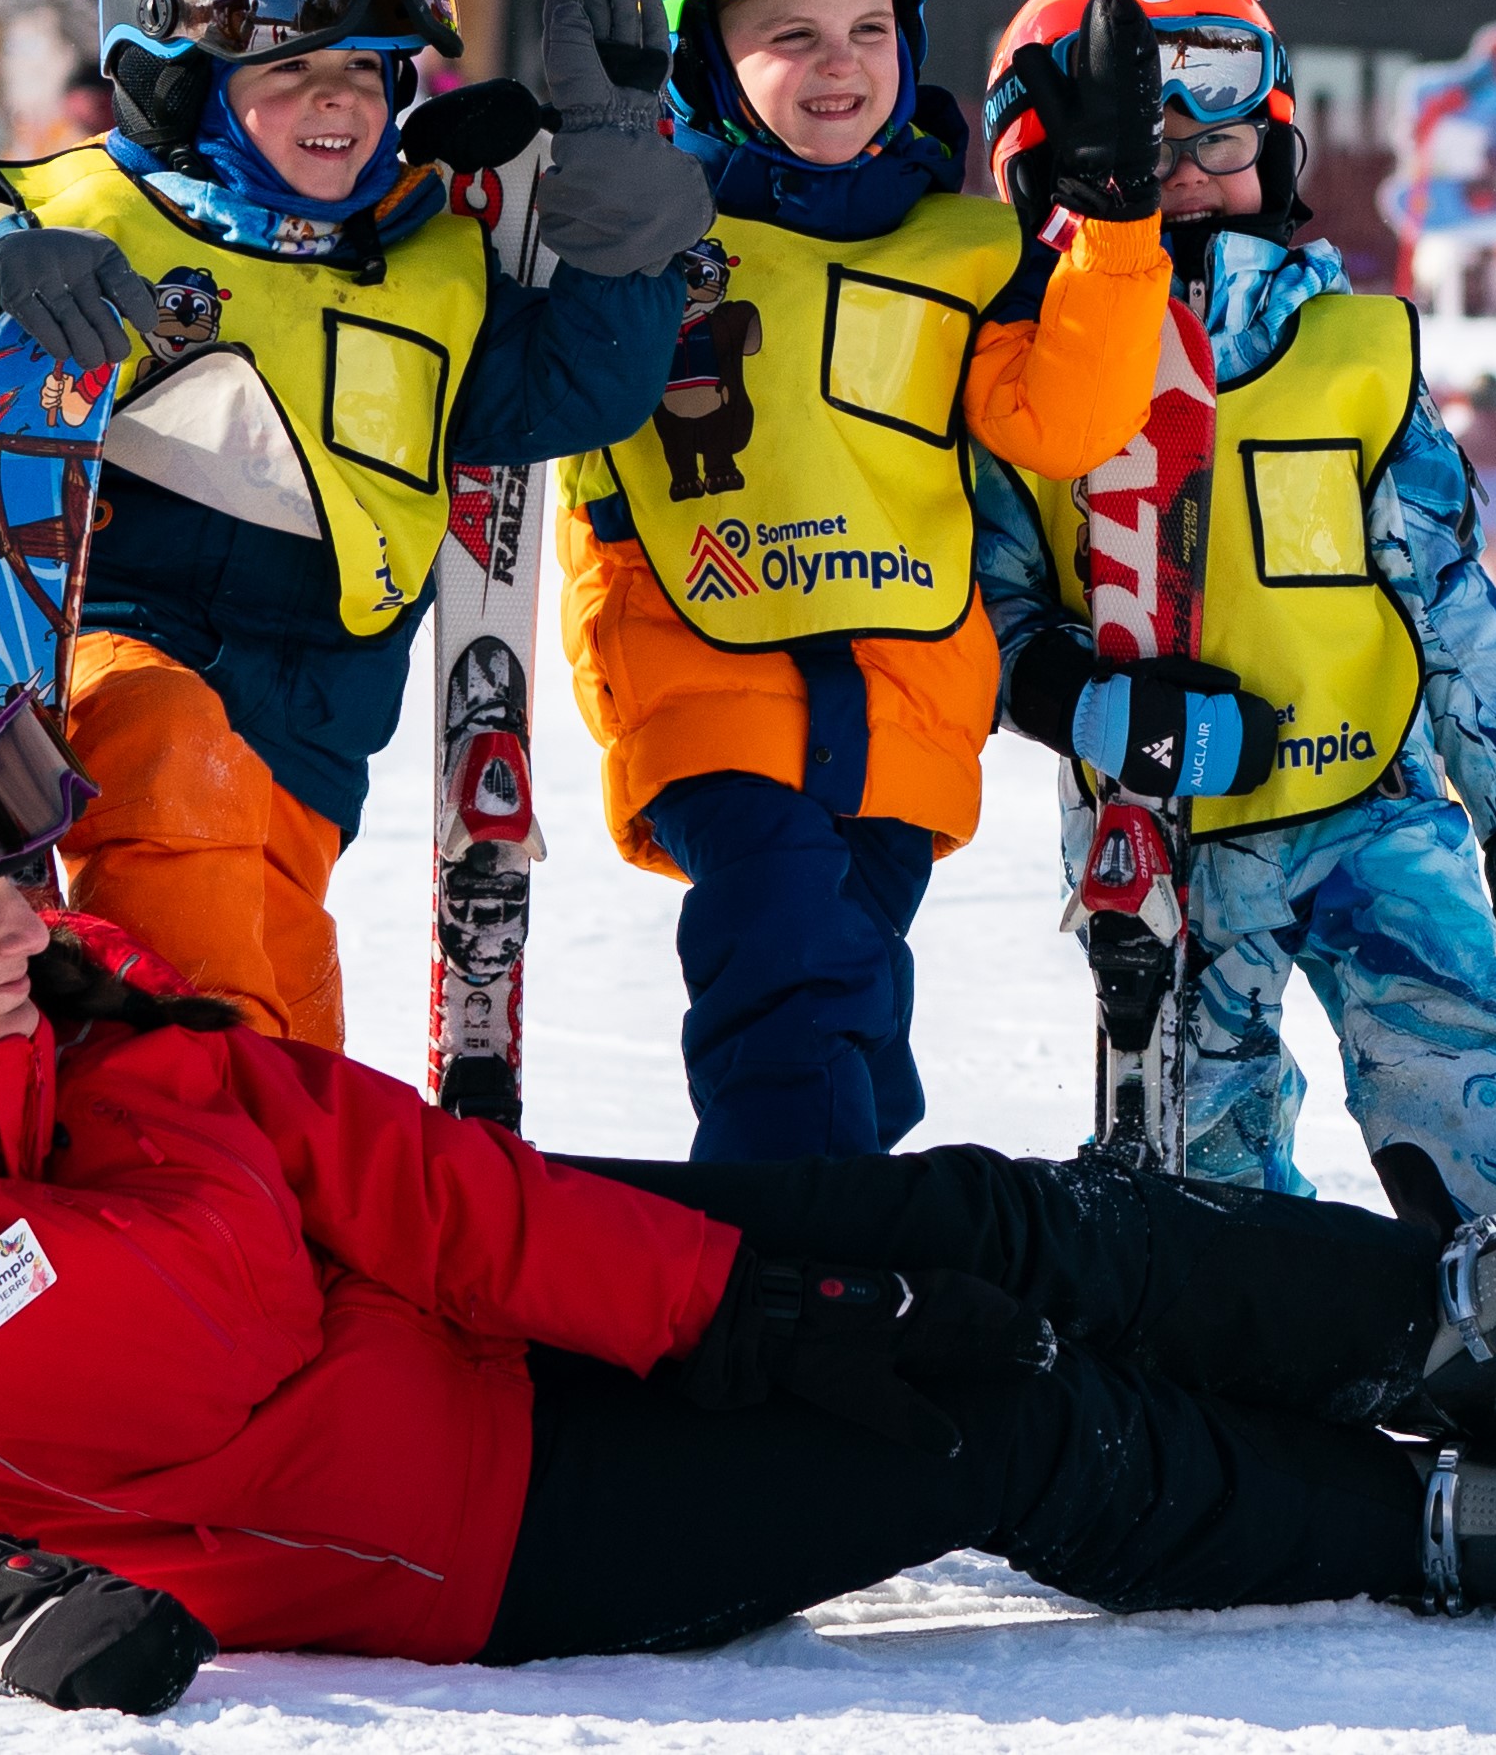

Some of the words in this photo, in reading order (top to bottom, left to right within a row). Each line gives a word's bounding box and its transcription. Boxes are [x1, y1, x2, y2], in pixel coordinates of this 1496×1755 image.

[756, 514, 847, 546] Sommet
[1182, 498, 1191, 564] ROCKER
[1190, 500, 1198, 547] PISTE
[761, 543, 934, 595] Olympia
[1190, 721, 1212, 788] AUCLAIR
[1277, 721, 1378, 776] mpia
